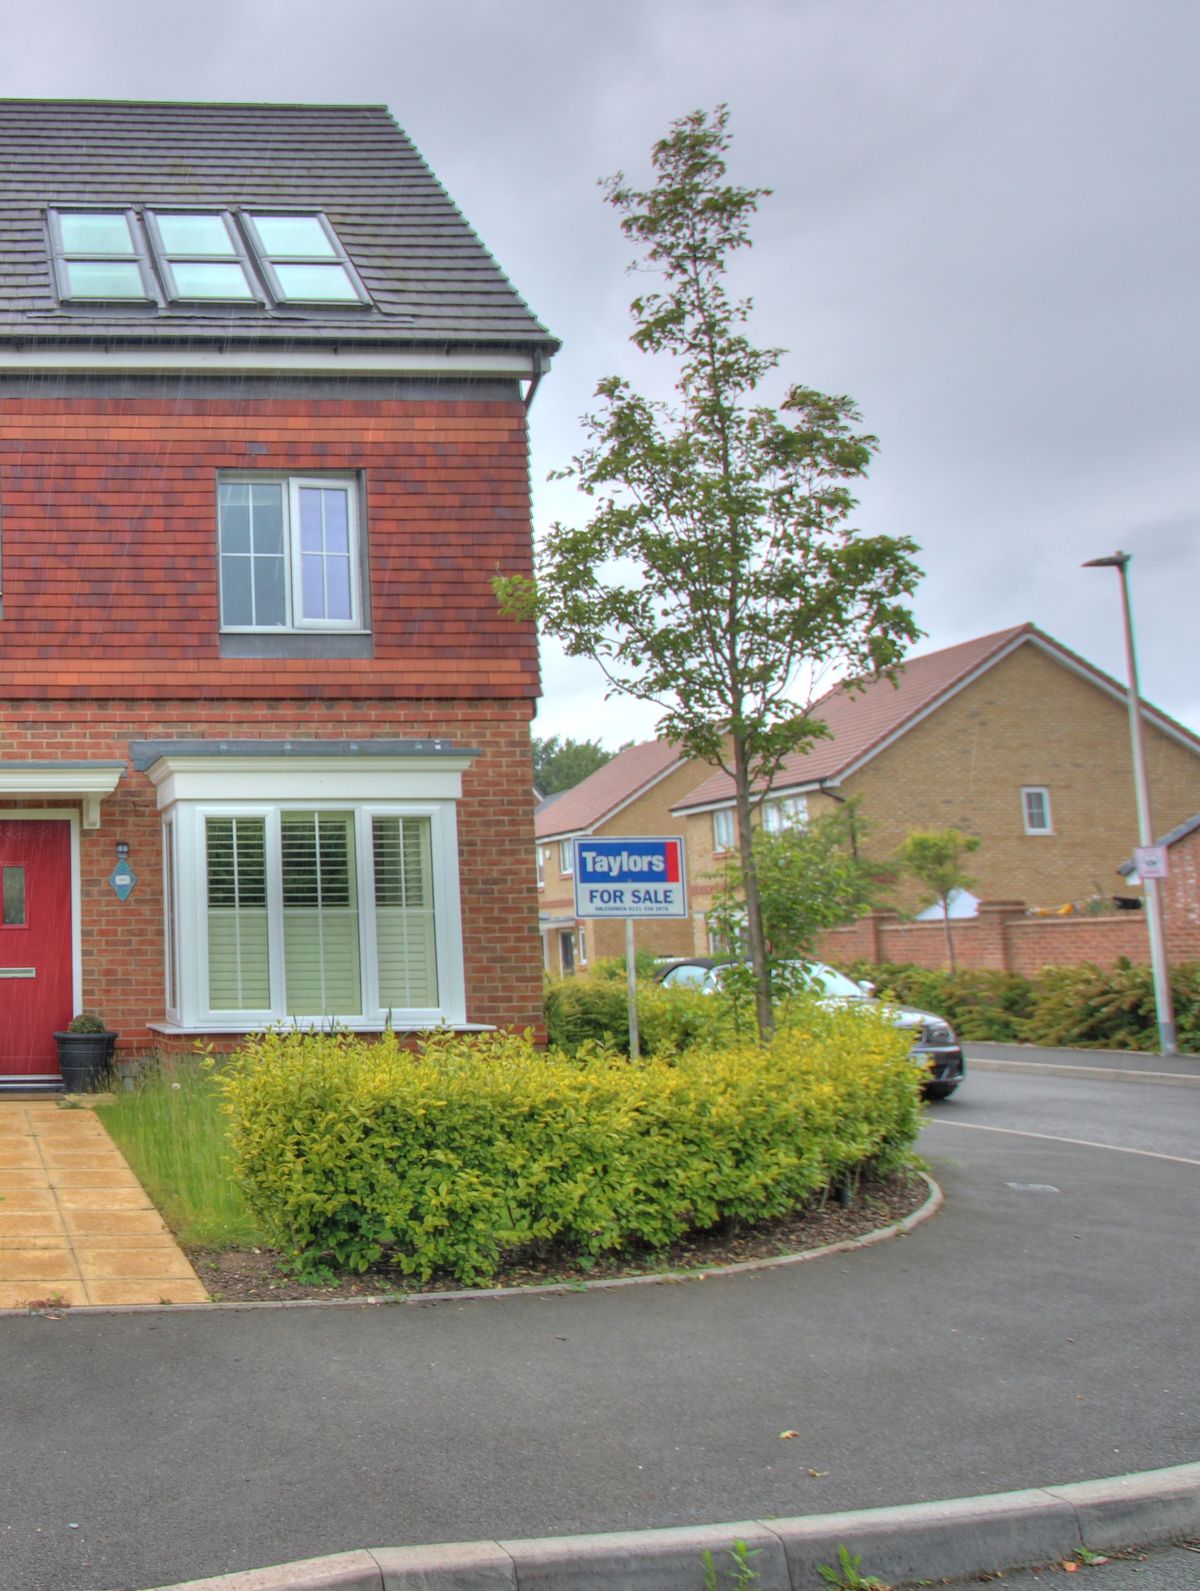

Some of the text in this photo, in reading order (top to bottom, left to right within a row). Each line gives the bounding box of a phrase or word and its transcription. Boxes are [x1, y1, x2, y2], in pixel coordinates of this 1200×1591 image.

[581, 851, 665, 877] Taylors
[589, 889, 673, 904] FOR SALE
